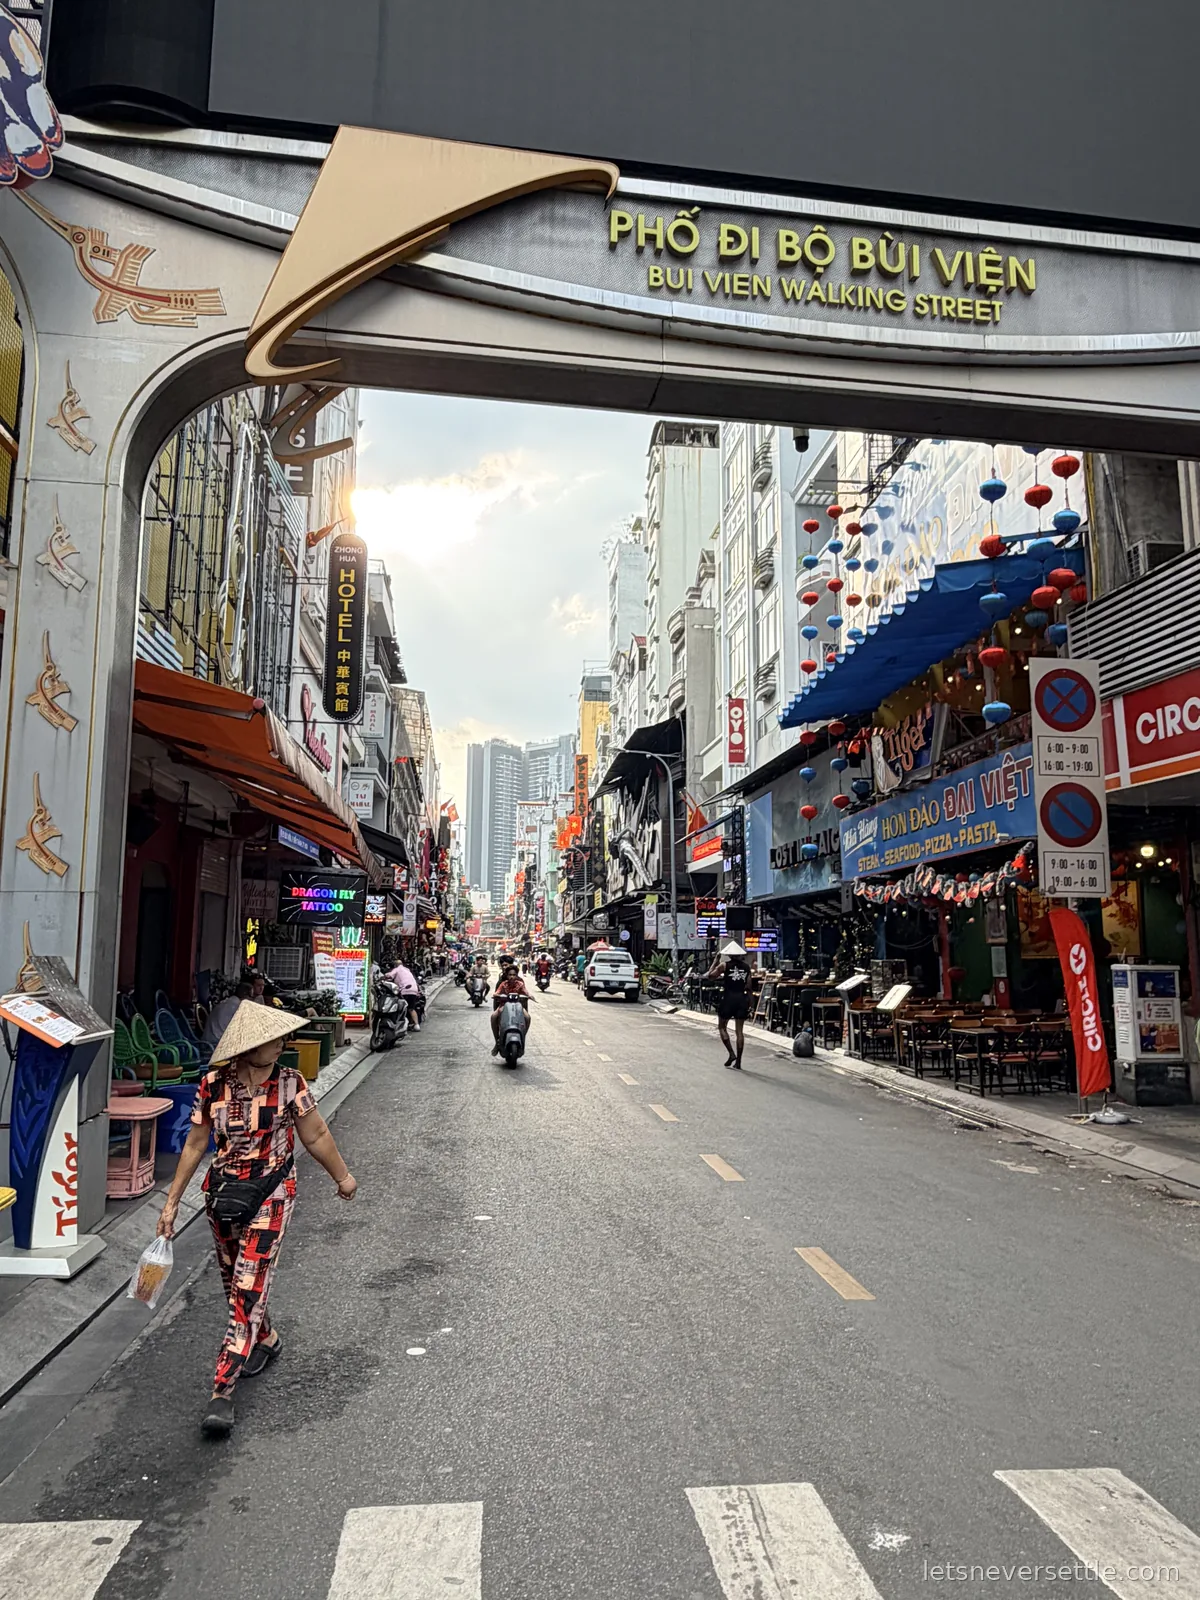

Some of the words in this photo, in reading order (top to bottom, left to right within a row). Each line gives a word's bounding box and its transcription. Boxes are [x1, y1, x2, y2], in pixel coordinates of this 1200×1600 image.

[609, 206, 701, 259] PHỐ
[718, 222, 760, 264] ĐI
[777, 225, 836, 278] BỘ
[850, 231, 921, 281] BÙI
[931, 247, 1036, 295] VIỆN
[648, 265, 693, 291] BUI
[703, 271, 772, 299] VIEN
[780, 277, 907, 312] WALKING
[914, 293, 1004, 323] STREET
[334, 545, 363, 554] ZHONG
[339, 555, 357, 563] HUA
[337, 568, 356, 643] HOTEL
[334, 649, 351, 713] 中華賓館
[730, 706, 743, 745] OYO
[1136, 696, 1200, 744] CIRC
[1047, 743, 1064, 754] 6:00
[1072, 743, 1089, 754] 9:00
[1044, 760, 1064, 771] 16:00
[1072, 761, 1093, 772] 19:00
[943, 777, 976, 826] ĐẠI
[980, 751, 1033, 812] VIỆT
[1051, 858, 1068, 869] 9:00
[1076, 859, 1097, 870] 16:00
[291, 886, 337, 898] DRAGON
[338, 889, 356, 900] FLY
[1051, 875, 1072, 887] 19:00
[1080, 876, 1097, 887] 6:00
[301, 900, 344, 912] TATTOO
[1080, 975, 1102, 1051] CIRCLE
